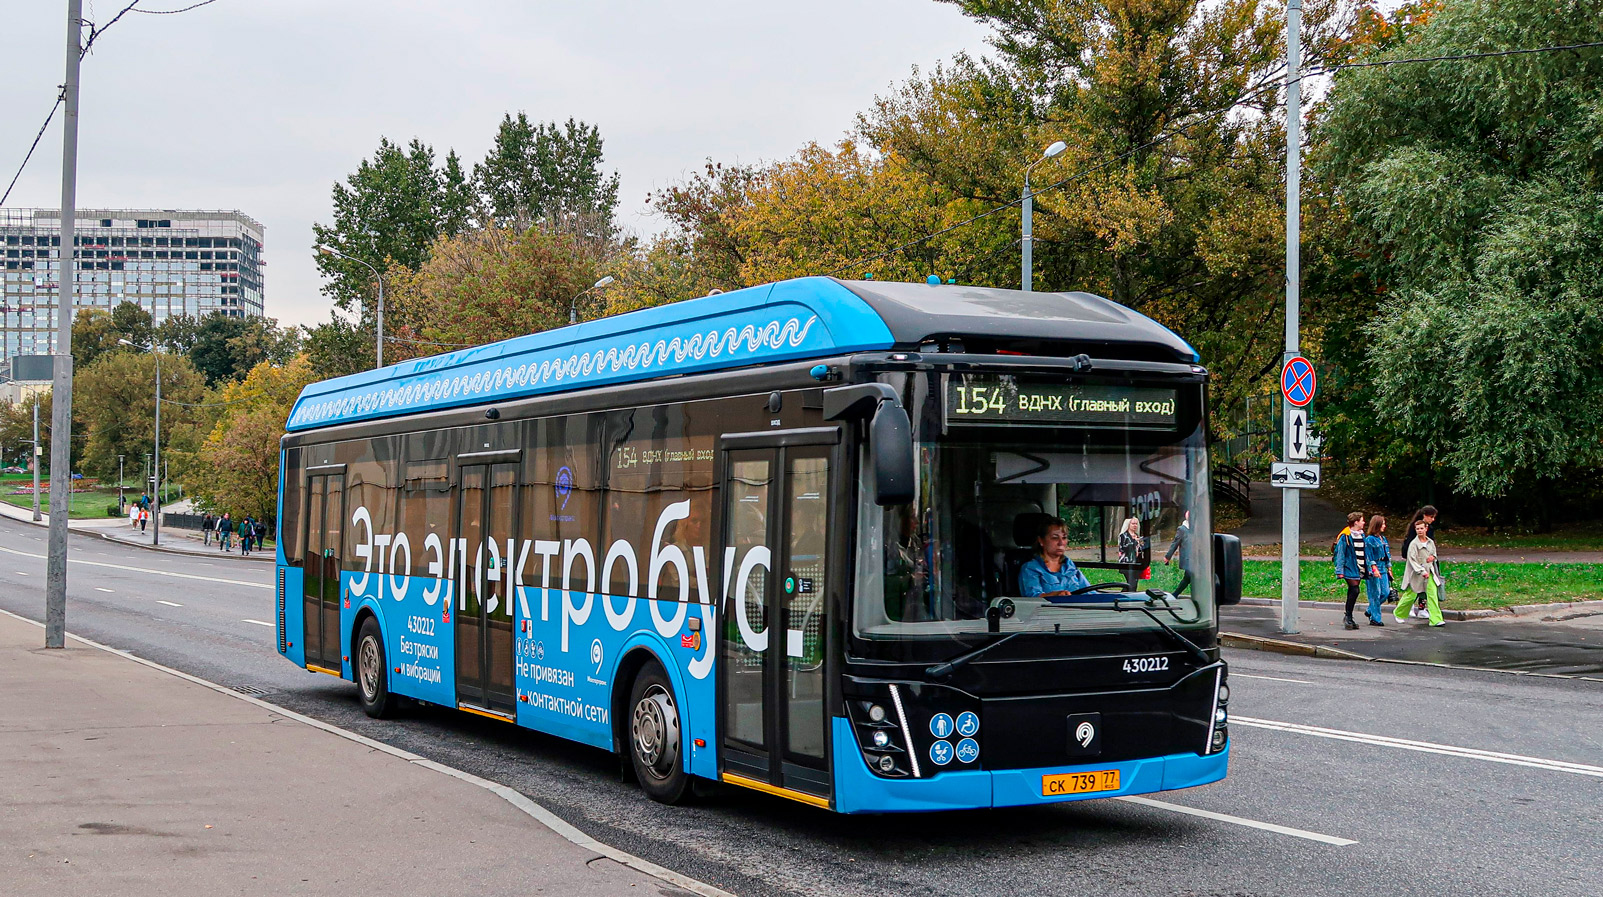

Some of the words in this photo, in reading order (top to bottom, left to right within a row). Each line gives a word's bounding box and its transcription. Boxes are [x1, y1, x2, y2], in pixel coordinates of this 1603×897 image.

[955, 386, 1006, 414] 154
[1018, 394, 1063, 412] ВДНХ
[1068, 395, 1130, 413] (главный
[1135, 398, 1175, 415] вход)
[617, 446, 638, 469] 154
[642, 449, 662, 465] ВДНХ
[348, 505, 412, 602] Это
[407, 615, 436, 637] 430212
[400, 635, 415, 655] Без
[413, 643, 439, 661] тряски
[400, 662, 406, 677] и
[406, 660, 441, 684] вибраций
[516, 655, 529, 678] Не
[530, 664, 575, 688] привязан
[1122, 656, 1169, 673] 430212
[527, 690, 584, 719] контактной
[584, 701, 610, 725] сети
[1049, 780, 1066, 793] СК
[1071, 774, 1096, 791] 739
[1103, 771, 1116, 784] 77
